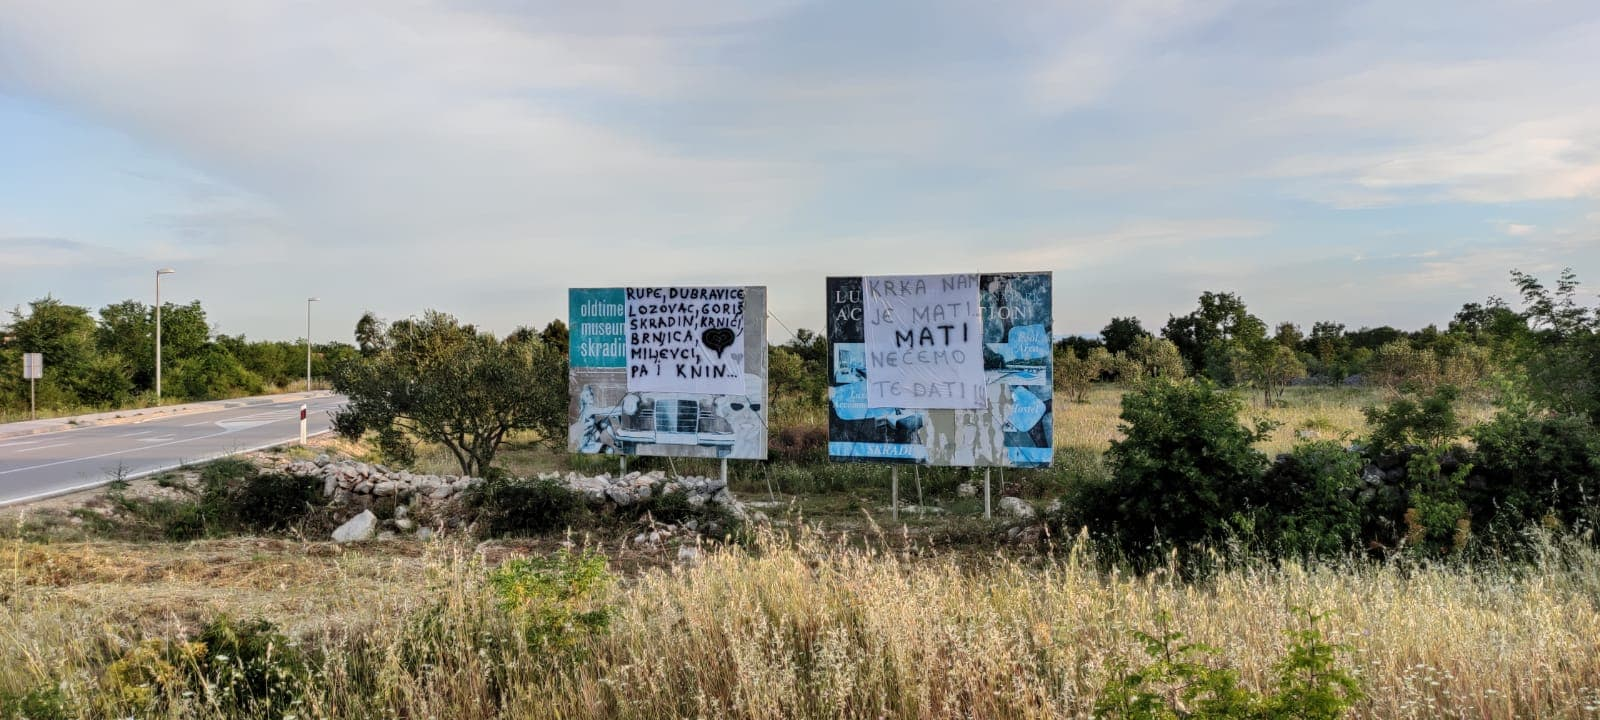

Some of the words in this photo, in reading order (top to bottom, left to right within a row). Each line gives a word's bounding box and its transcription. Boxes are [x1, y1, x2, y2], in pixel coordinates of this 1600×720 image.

[869, 279, 926, 297] KRKA
[942, 274, 979, 292] NAM
[626, 287, 666, 304] RUPE,
[580, 299, 624, 317] oldtime
[629, 302, 699, 319] LOZOVAC,
[872, 307, 893, 326] JE
[630, 315, 698, 330] SKRADIN,
[895, 322, 968, 348] MATI
[631, 364, 648, 378] PA
[873, 381, 902, 398] TE
